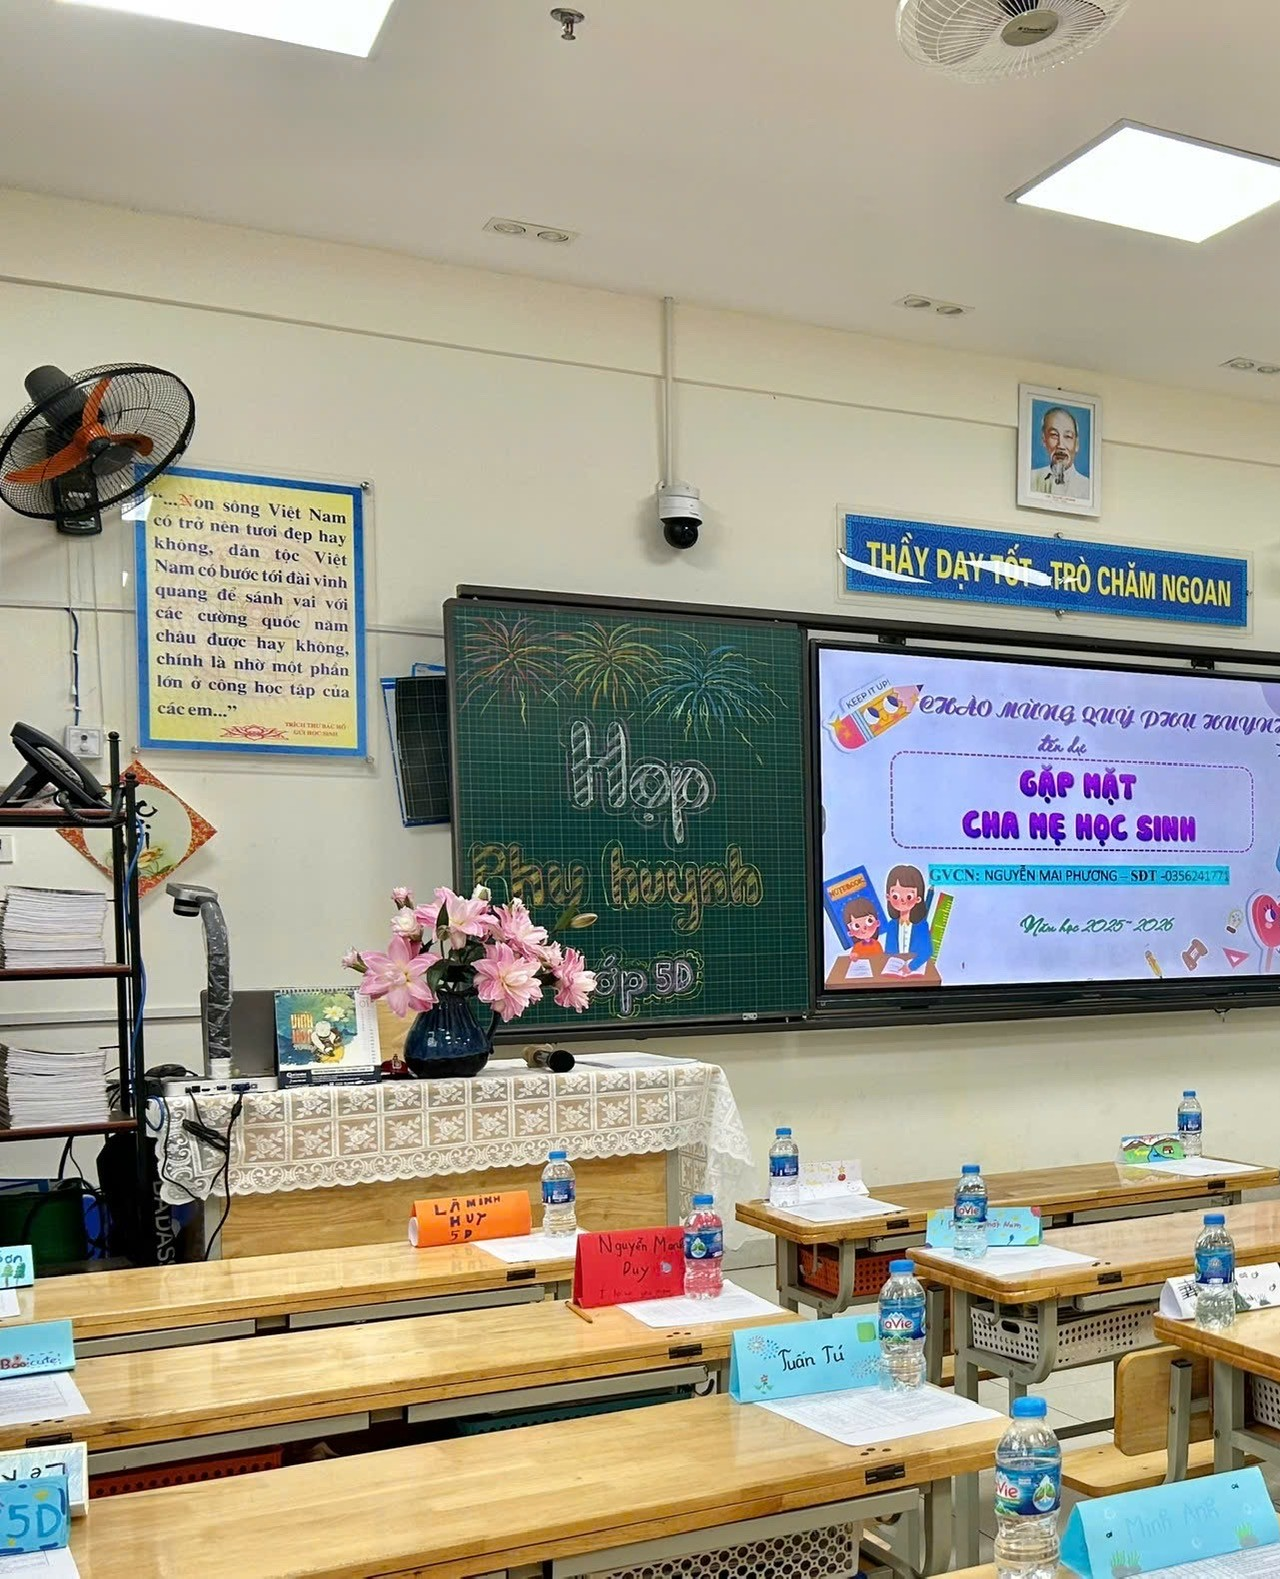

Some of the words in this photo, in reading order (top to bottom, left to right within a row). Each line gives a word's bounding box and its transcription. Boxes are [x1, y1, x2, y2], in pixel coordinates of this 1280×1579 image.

[223, 501, 260, 518] sông
[269, 503, 301, 522] Việt
[310, 508, 346, 524] Nam
[154, 513, 172, 527] có
[179, 516, 205, 530] trở
[210, 520, 239, 534] nên
[246, 524, 277, 538] tươi
[284, 527, 312, 544] đẹp
[319, 530, 347, 547] hay
[154, 536, 214, 556] không,
[229, 543, 260, 558] dân
[275, 549, 300, 564] tộc
[315, 551, 347, 569] Việt
[155, 559, 194, 576] Nam
[198, 563, 216, 577] có
[220, 565, 258, 581] bước
[262, 569, 282, 584] tới
[286, 571, 310, 586] đài
[315, 574, 347, 588] vinh
[867, 532, 929, 577] THẦY
[936, 548, 984, 590] DẠY
[990, 543, 1032, 587] TỐT
[1050, 556, 1091, 593] TRÒ
[1097, 562, 1156, 600] CHĂM
[1162, 574, 1232, 607] NGOAN
[155, 585, 208, 602] quang
[217, 586, 236, 601] để
[246, 590, 283, 605] sánh
[293, 594, 315, 608] vai
[326, 597, 348, 611] với
[156, 607, 182, 620] các
[198, 611, 247, 628] cường
[262, 613, 301, 630] quốc
[156, 629, 196, 644] châu
[207, 633, 246, 650] được
[257, 636, 286, 653] hay
[297, 639, 349, 657] không,
[156, 653, 203, 668] chính
[211, 655, 226, 669] là
[234, 658, 264, 671] nhờ
[272, 661, 302, 676] một
[310, 662, 349, 678] phần
[157, 675, 182, 689] lớn
[191, 676, 201, 690] ở
[209, 680, 247, 696] công
[254, 680, 283, 697] học
[290, 684, 315, 699] tập
[323, 684, 349, 698] của
[845, 691, 868, 709] KEEP
[866, 687, 877, 699] IT
[876, 678, 891, 694] UP!
[158, 702, 185, 716] các
[919, 694, 993, 717] CHÀO
[995, 698, 1076, 726] MỪNG
[1037, 734, 1065, 753] đến
[570, 718, 713, 846] Họp
[1019, 764, 1075, 804] GẶP
[1083, 766, 1137, 806] MẶT
[962, 810, 1019, 839] CHA
[1029, 812, 1067, 847] MẸ
[1075, 813, 1128, 847] HỌC
[1136, 814, 1196, 842] SINH
[929, 868, 980, 882] GVCN:
[984, 864, 1036, 882] NGUYỄN
[1039, 870, 1063, 882] MAI
[1065, 869, 1118, 882] PHƯƠNG
[1019, 914, 1057, 937] Năm
[1058, 918, 1080, 934] học
[1133, 917, 1175, 932] 2026
[595, 946, 646, 1016] ớp
[653, 958, 699, 996] 5D
[466, 1195, 501, 1208] MINH
[450, 1212, 487, 1227] HUY
[599, 1234, 648, 1258] Nguyễn
[623, 1261, 649, 1283] Duy
[884, 1317, 913, 1329] aVie
[778, 1347, 816, 1372] Tuấn
[822, 1344, 845, 1365] Tú
[996, 1481, 1018, 1498] Vie
[6, 1503, 62, 1538] 5D
